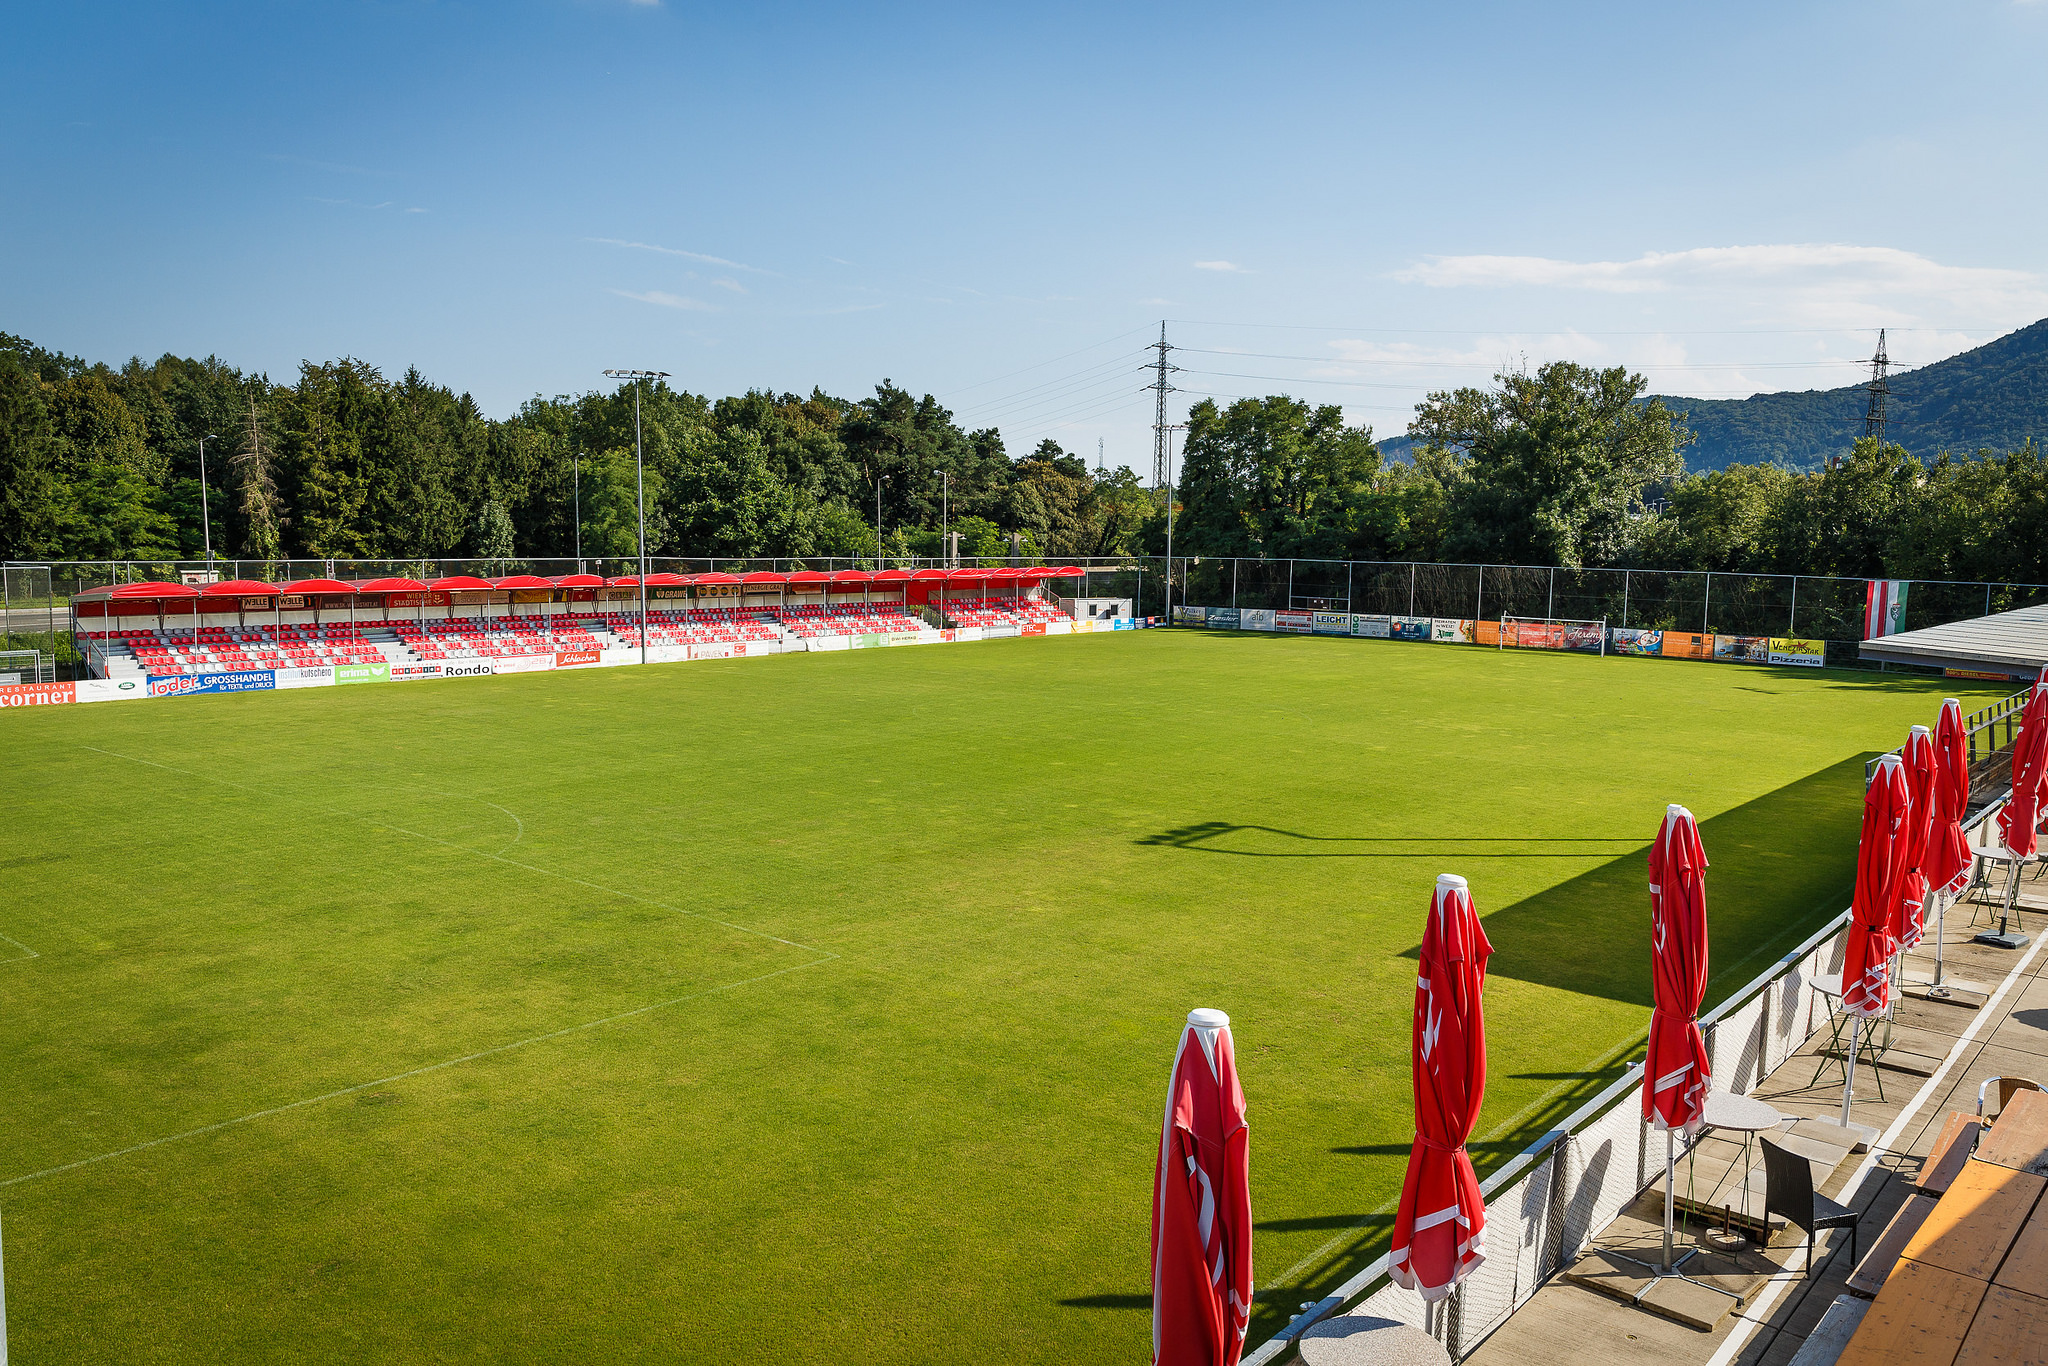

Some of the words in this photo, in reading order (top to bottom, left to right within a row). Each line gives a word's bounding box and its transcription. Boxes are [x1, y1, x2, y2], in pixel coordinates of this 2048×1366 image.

[1252, 611, 1264, 621] afb
[1316, 615, 1347, 624] LEICHT
[1568, 627, 1610, 645] Jeremy's
[1771, 655, 1821, 665] Pizzeria
[339, 667, 370, 678] erima
[446, 664, 490, 677] Rondo
[204, 672, 274, 686] GROSSHANDEL
[0, 683, 73, 693] RESTAURANT
[152, 676, 198, 696] loder
[0, 690, 74, 708] corner
